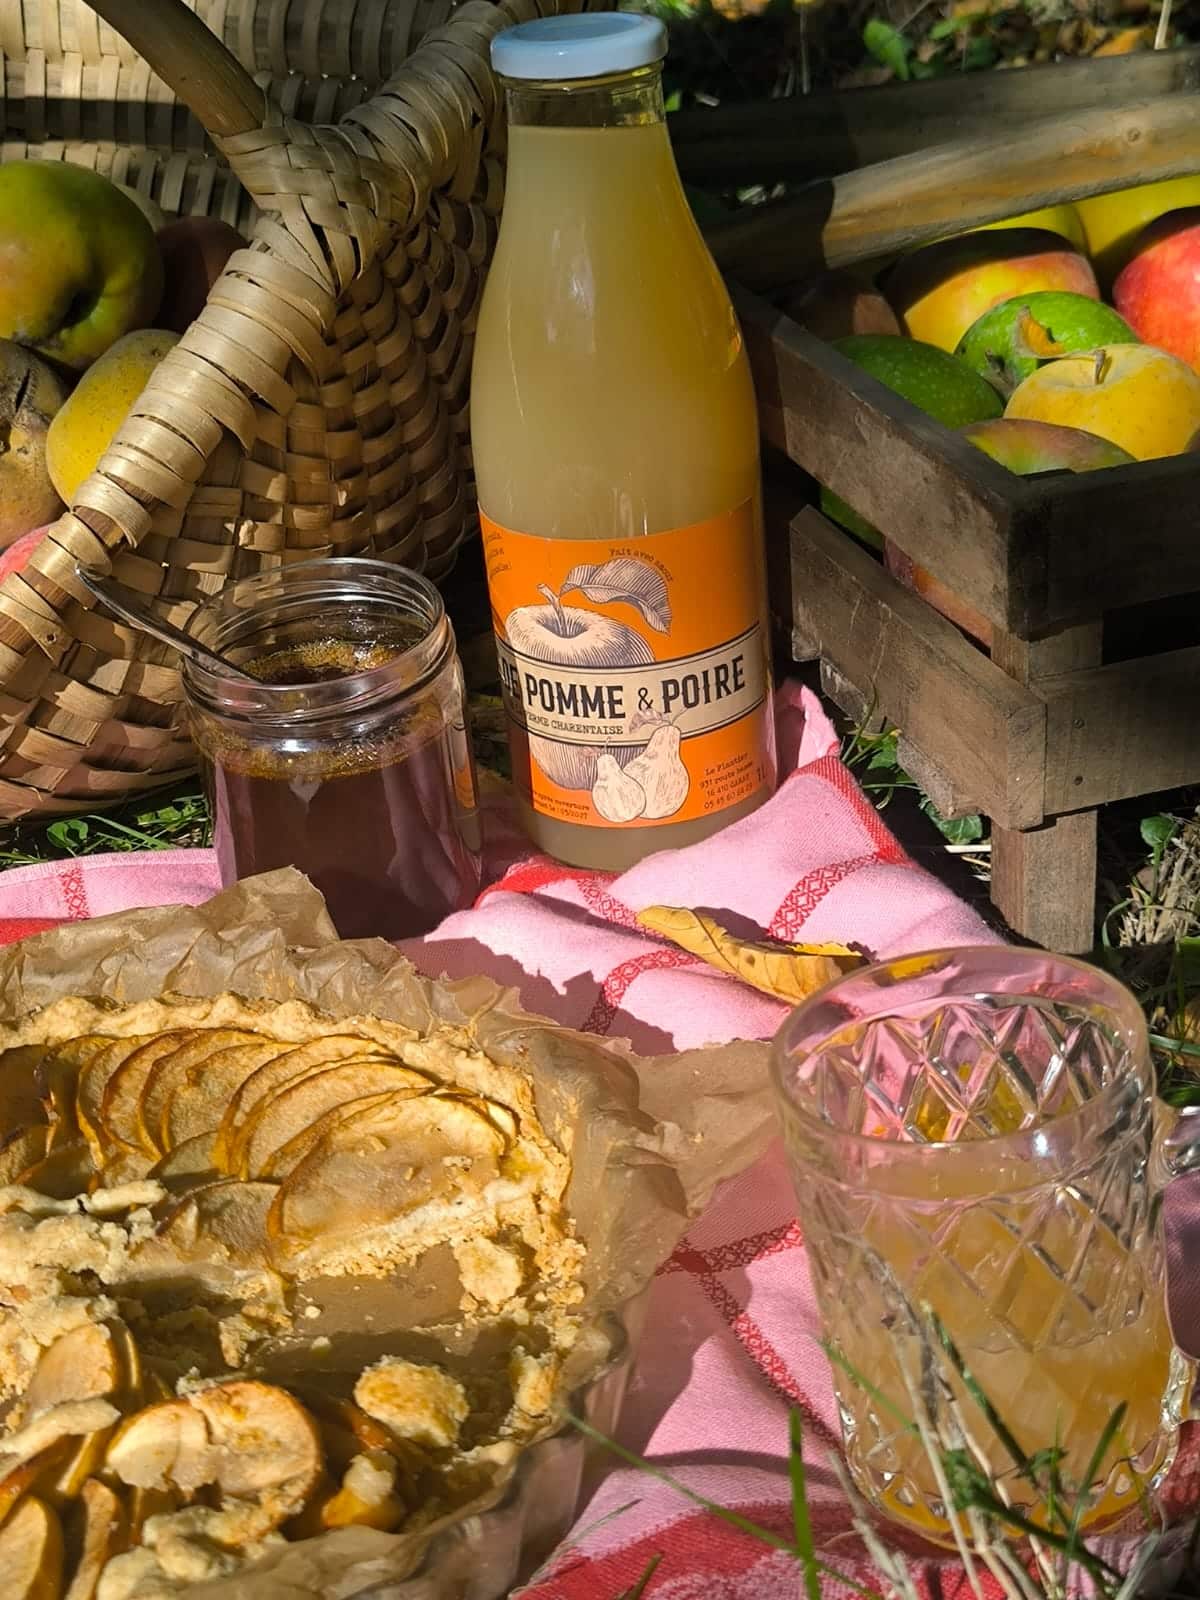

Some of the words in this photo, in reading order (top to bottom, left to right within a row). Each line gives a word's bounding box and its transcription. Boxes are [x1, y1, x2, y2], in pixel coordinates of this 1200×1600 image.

[525, 672, 626, 719] POMME
[638, 687, 654, 711] &
[661, 654, 745, 713] POIRE
[551, 719, 624, 735] CHARENTAISE
